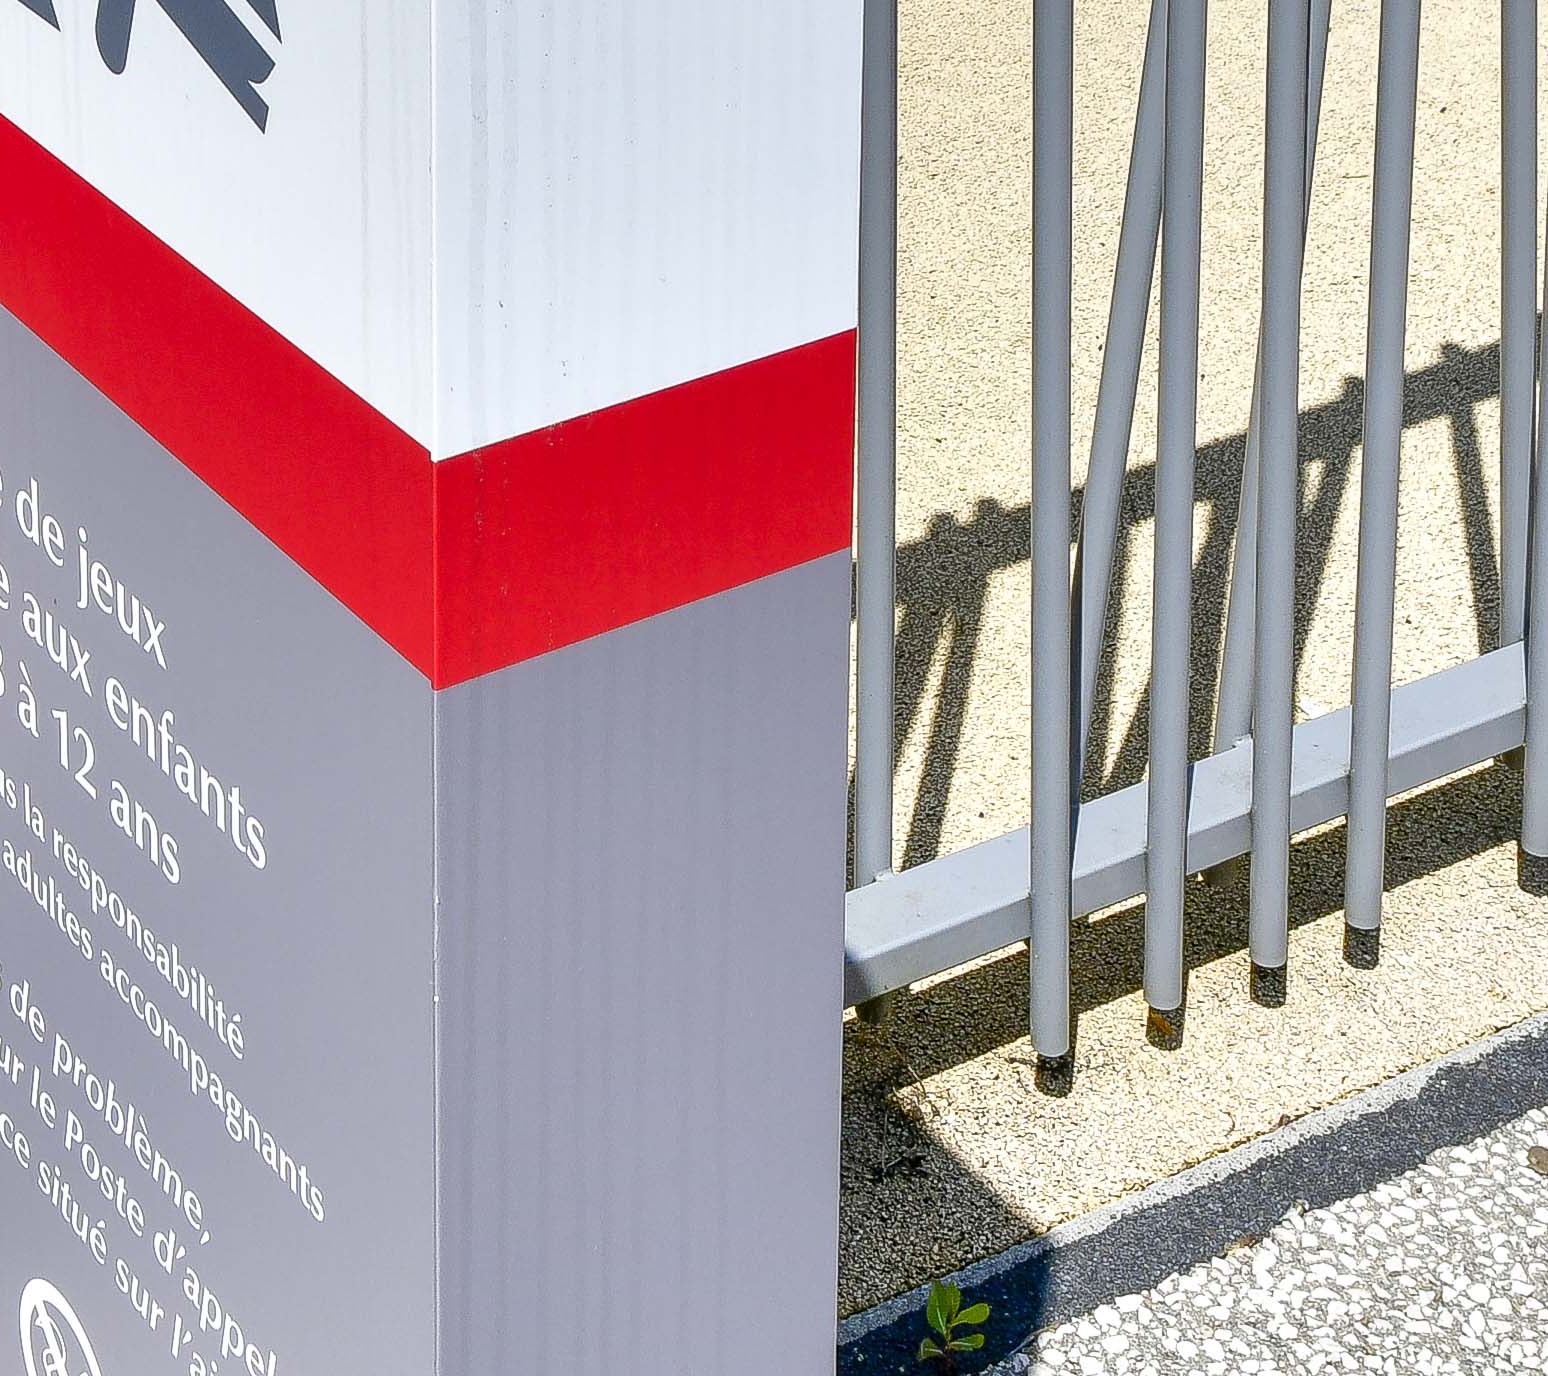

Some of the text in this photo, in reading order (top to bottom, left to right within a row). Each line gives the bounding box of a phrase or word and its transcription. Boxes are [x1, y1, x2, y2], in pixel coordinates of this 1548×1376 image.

[15, 477, 65, 568] de
[77, 527, 168, 670] jeux
[17, 660, 40, 738] à
[51, 708, 97, 800] 12
[108, 779, 181, 885] ans
[22, 592, 93, 697] aux
[105, 674, 267, 870] enfants
[2, 839, 94, 961] adultes
[100, 949, 325, 1222] accompagnants
[24, 783, 46, 843] la
[53, 828, 245, 1060] responsabilité
[9, 979, 46, 1043] de
[53, 1032, 211, 1246] problème,
[31, 1064, 56, 1129] le
[64, 1109, 146, 1237] Poste
[37, 1160, 107, 1265] situé
[115, 1258, 165, 1331] sur
